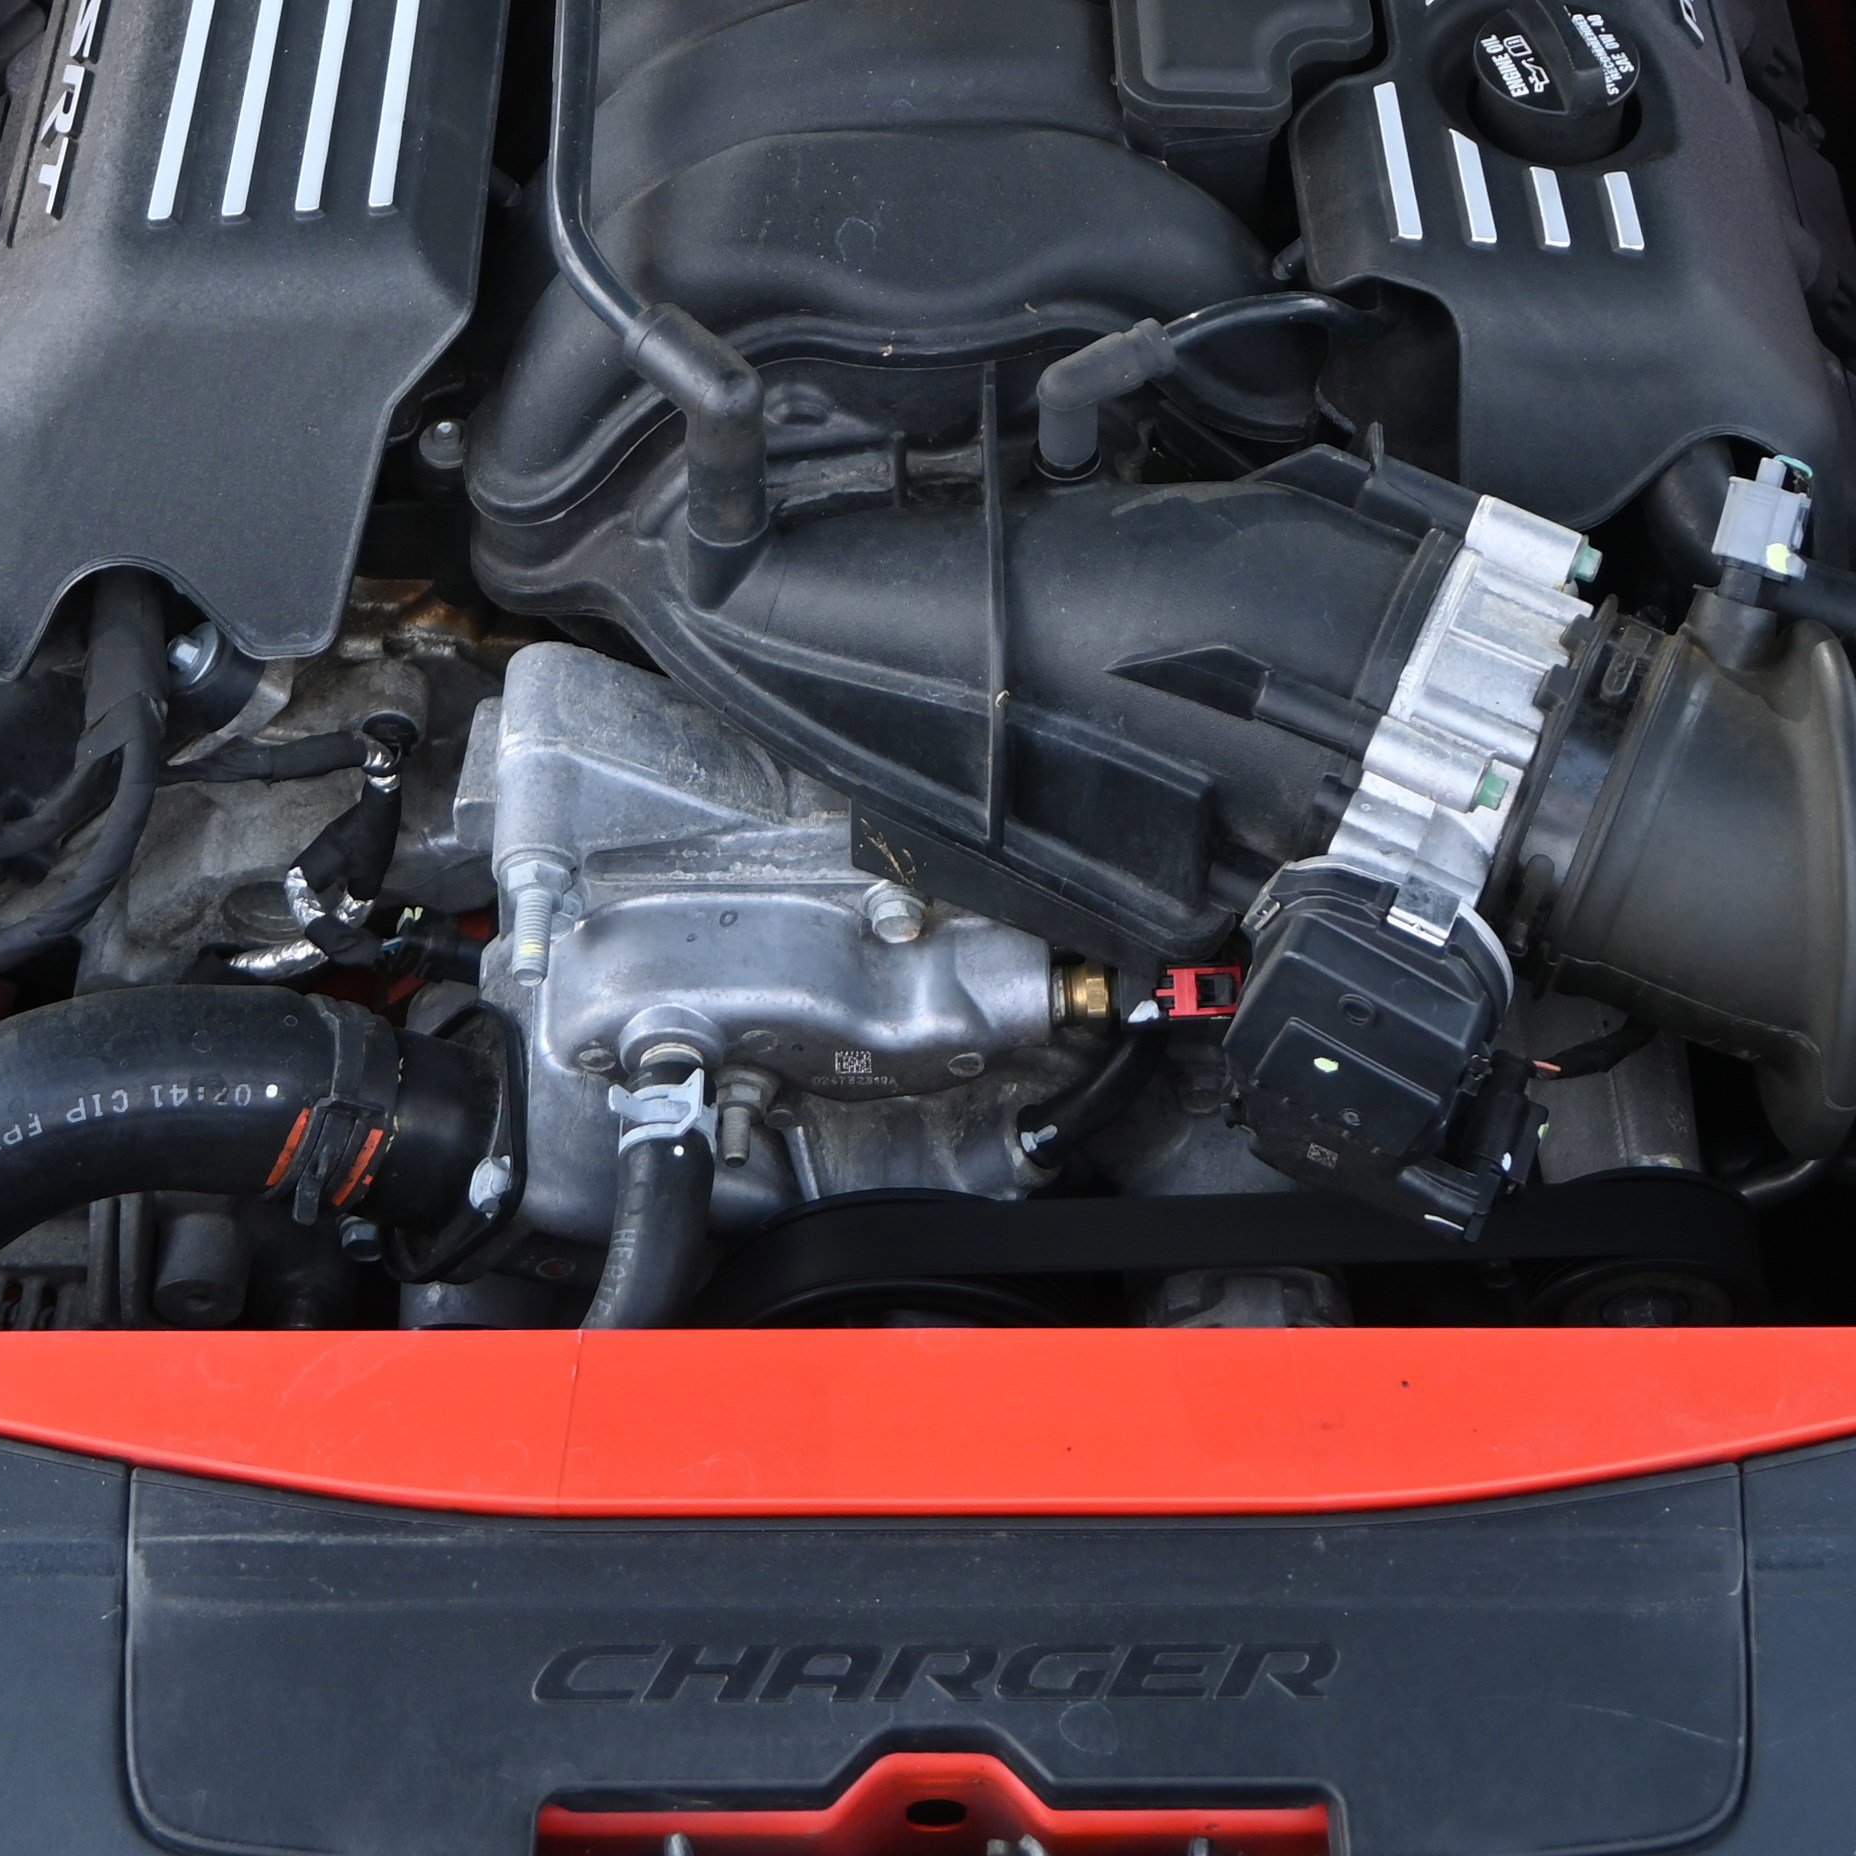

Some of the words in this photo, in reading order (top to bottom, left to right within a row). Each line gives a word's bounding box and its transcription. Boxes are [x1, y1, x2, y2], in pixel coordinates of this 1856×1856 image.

[1480, 34, 1504, 54] OIL
[1571, 14, 1623, 81] RECOMMENDED
[1613, 52, 1635, 73] SAE
[1491, 54, 1530, 98] ENGINE
[63, 1087, 130, 1124] CIP
[533, 1639, 1341, 1704] CHARGER
